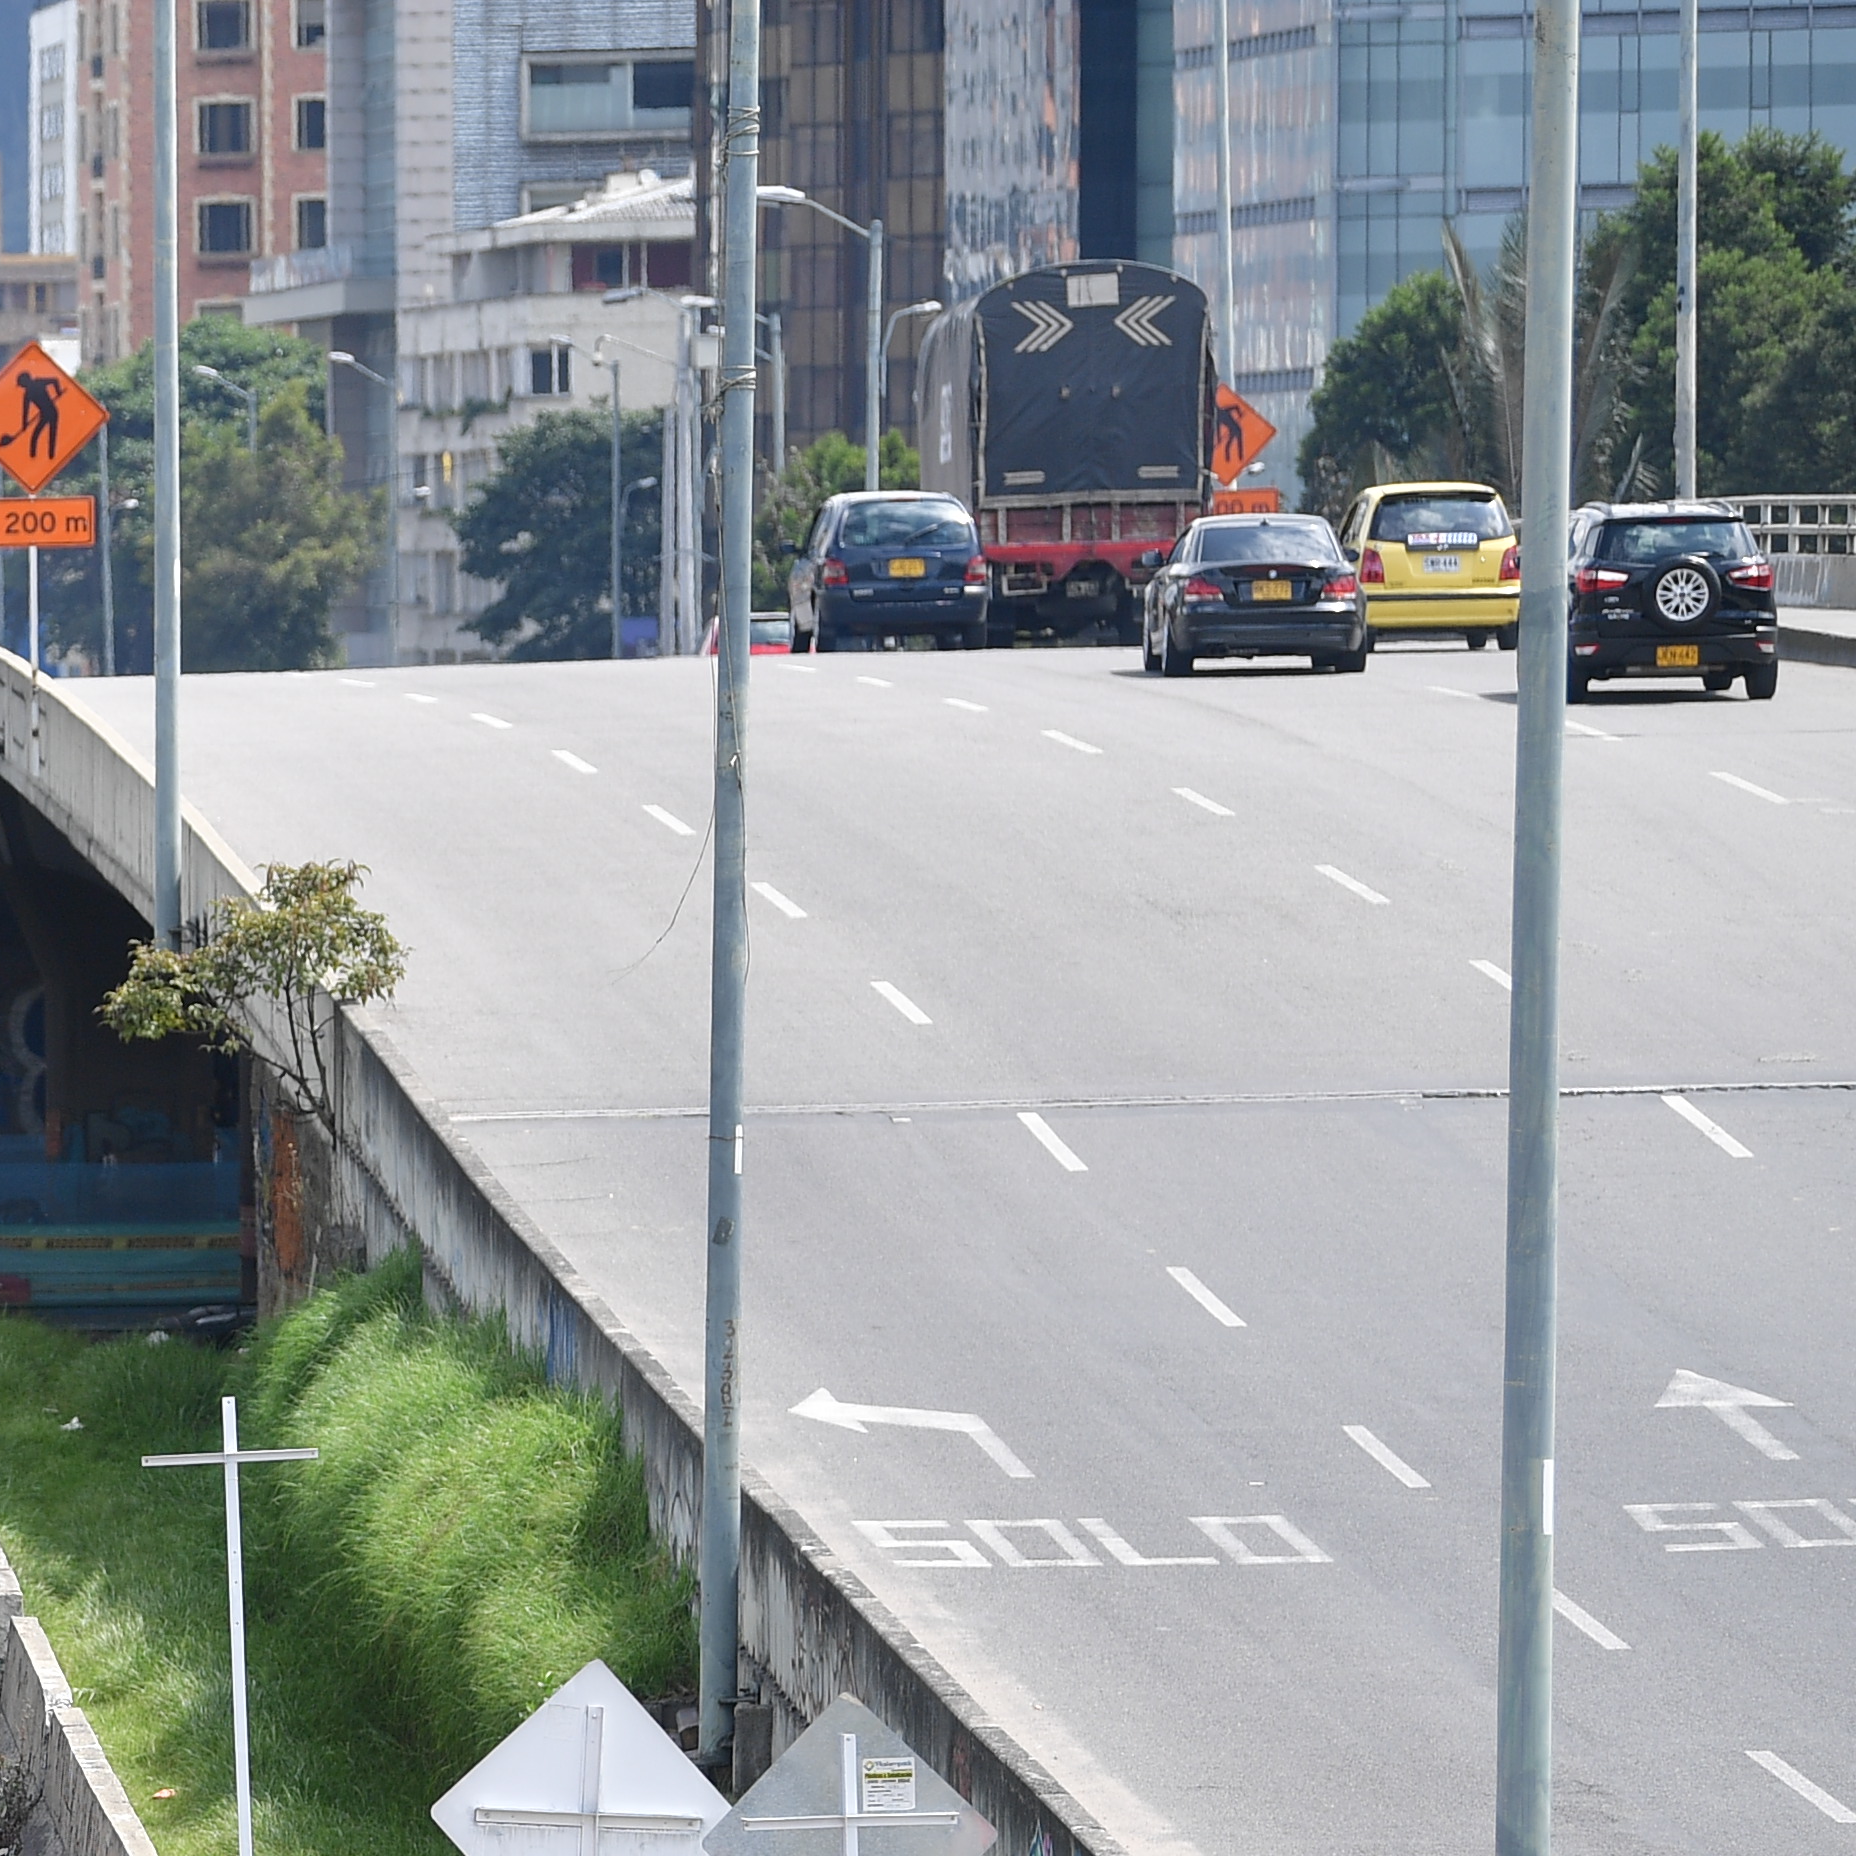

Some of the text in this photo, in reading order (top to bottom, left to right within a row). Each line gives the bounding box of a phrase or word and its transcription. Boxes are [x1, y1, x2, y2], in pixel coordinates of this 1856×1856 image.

[5, 511, 56, 534] 200
[65, 515, 87, 532] m
[851, 1514, 1334, 1567] SOLO
[1622, 1498, 1856, 1552] SO
